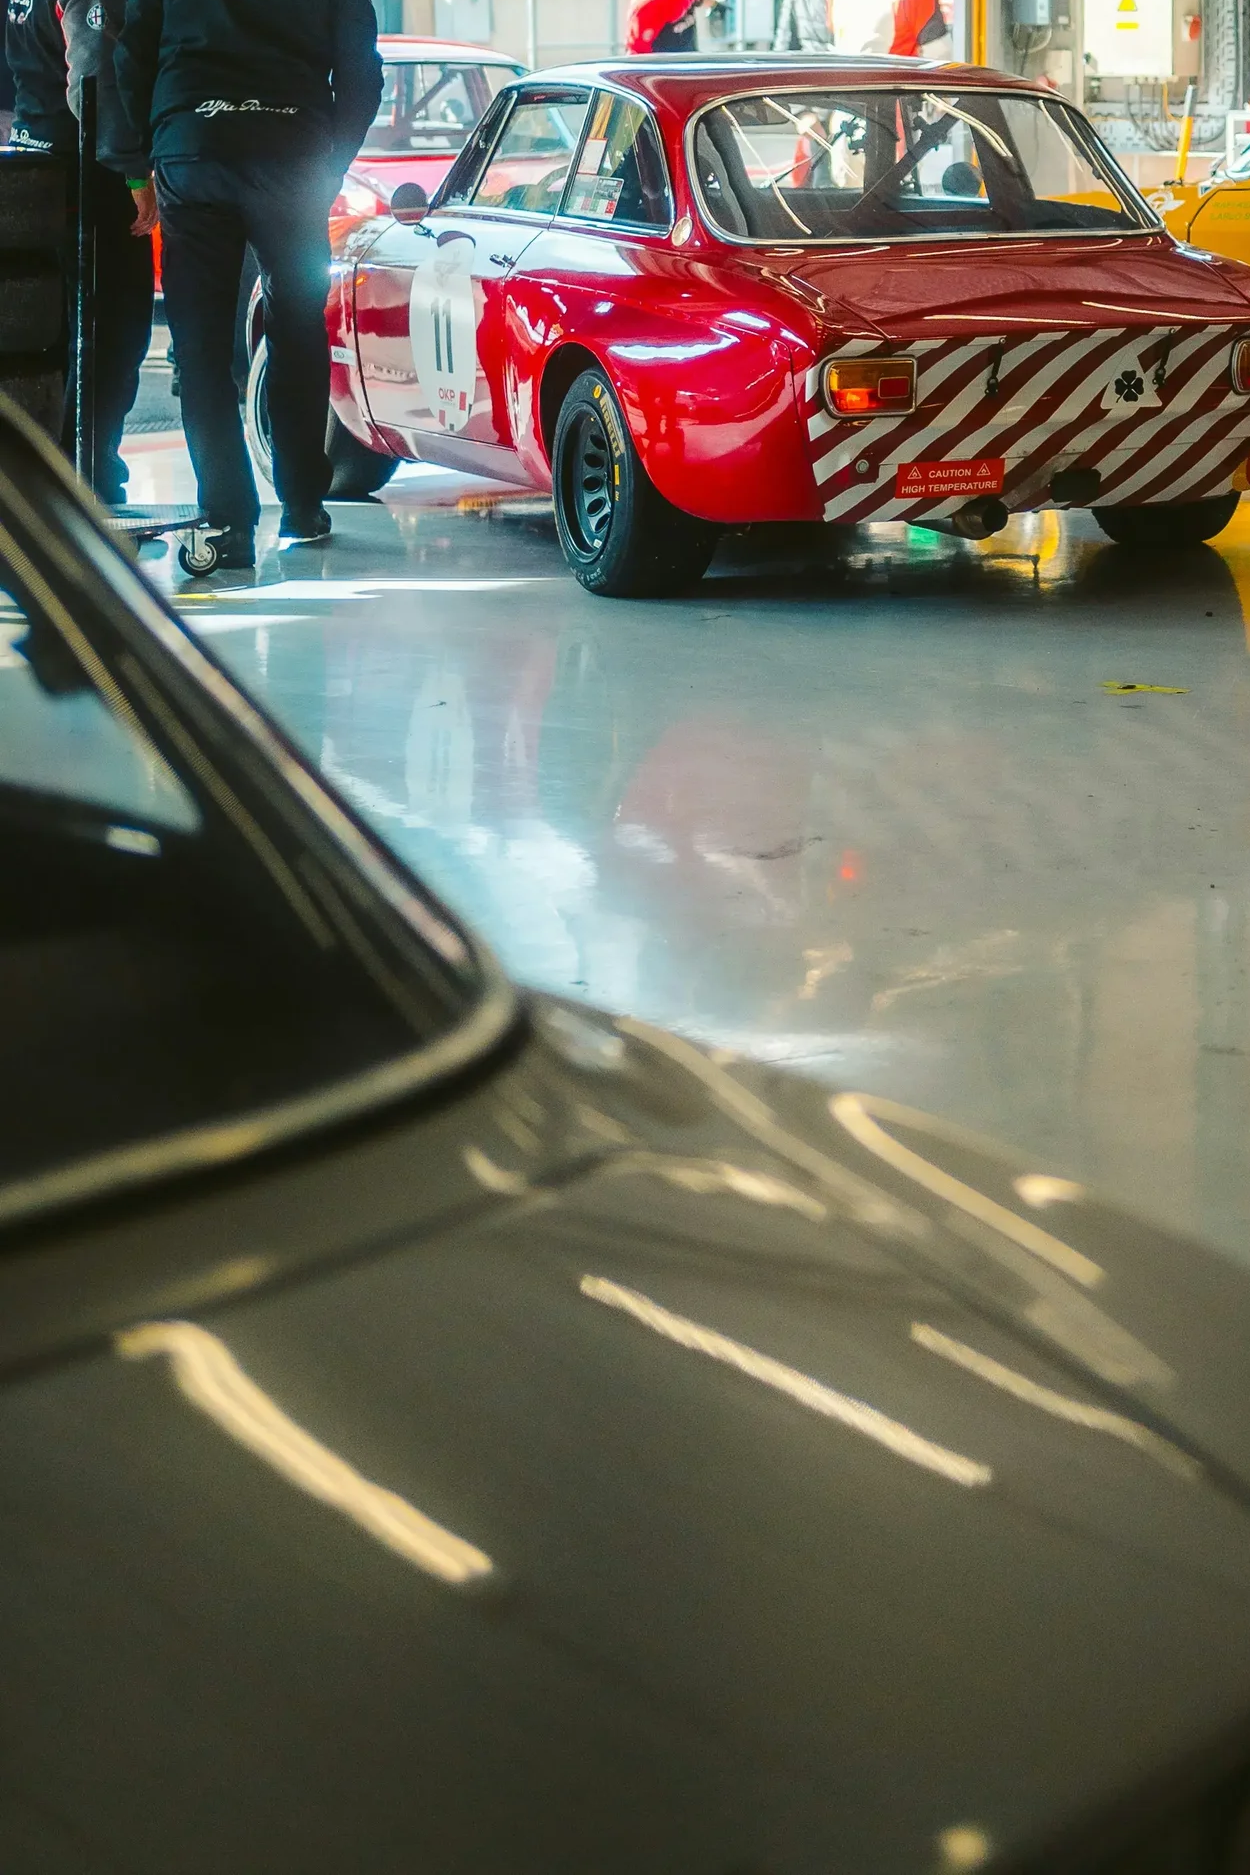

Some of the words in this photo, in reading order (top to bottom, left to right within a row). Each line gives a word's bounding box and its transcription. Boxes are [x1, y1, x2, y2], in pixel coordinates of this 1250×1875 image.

[195, 100, 237, 118] Alfa
[431, 296, 454, 374] 11
[438, 387, 456, 401] OKP
[600, 392, 626, 457] PIRELLI
[928, 468, 972, 479] CAUTION
[901, 485, 925, 494] HIGH
[929, 480, 998, 492] TEMPERATURE
